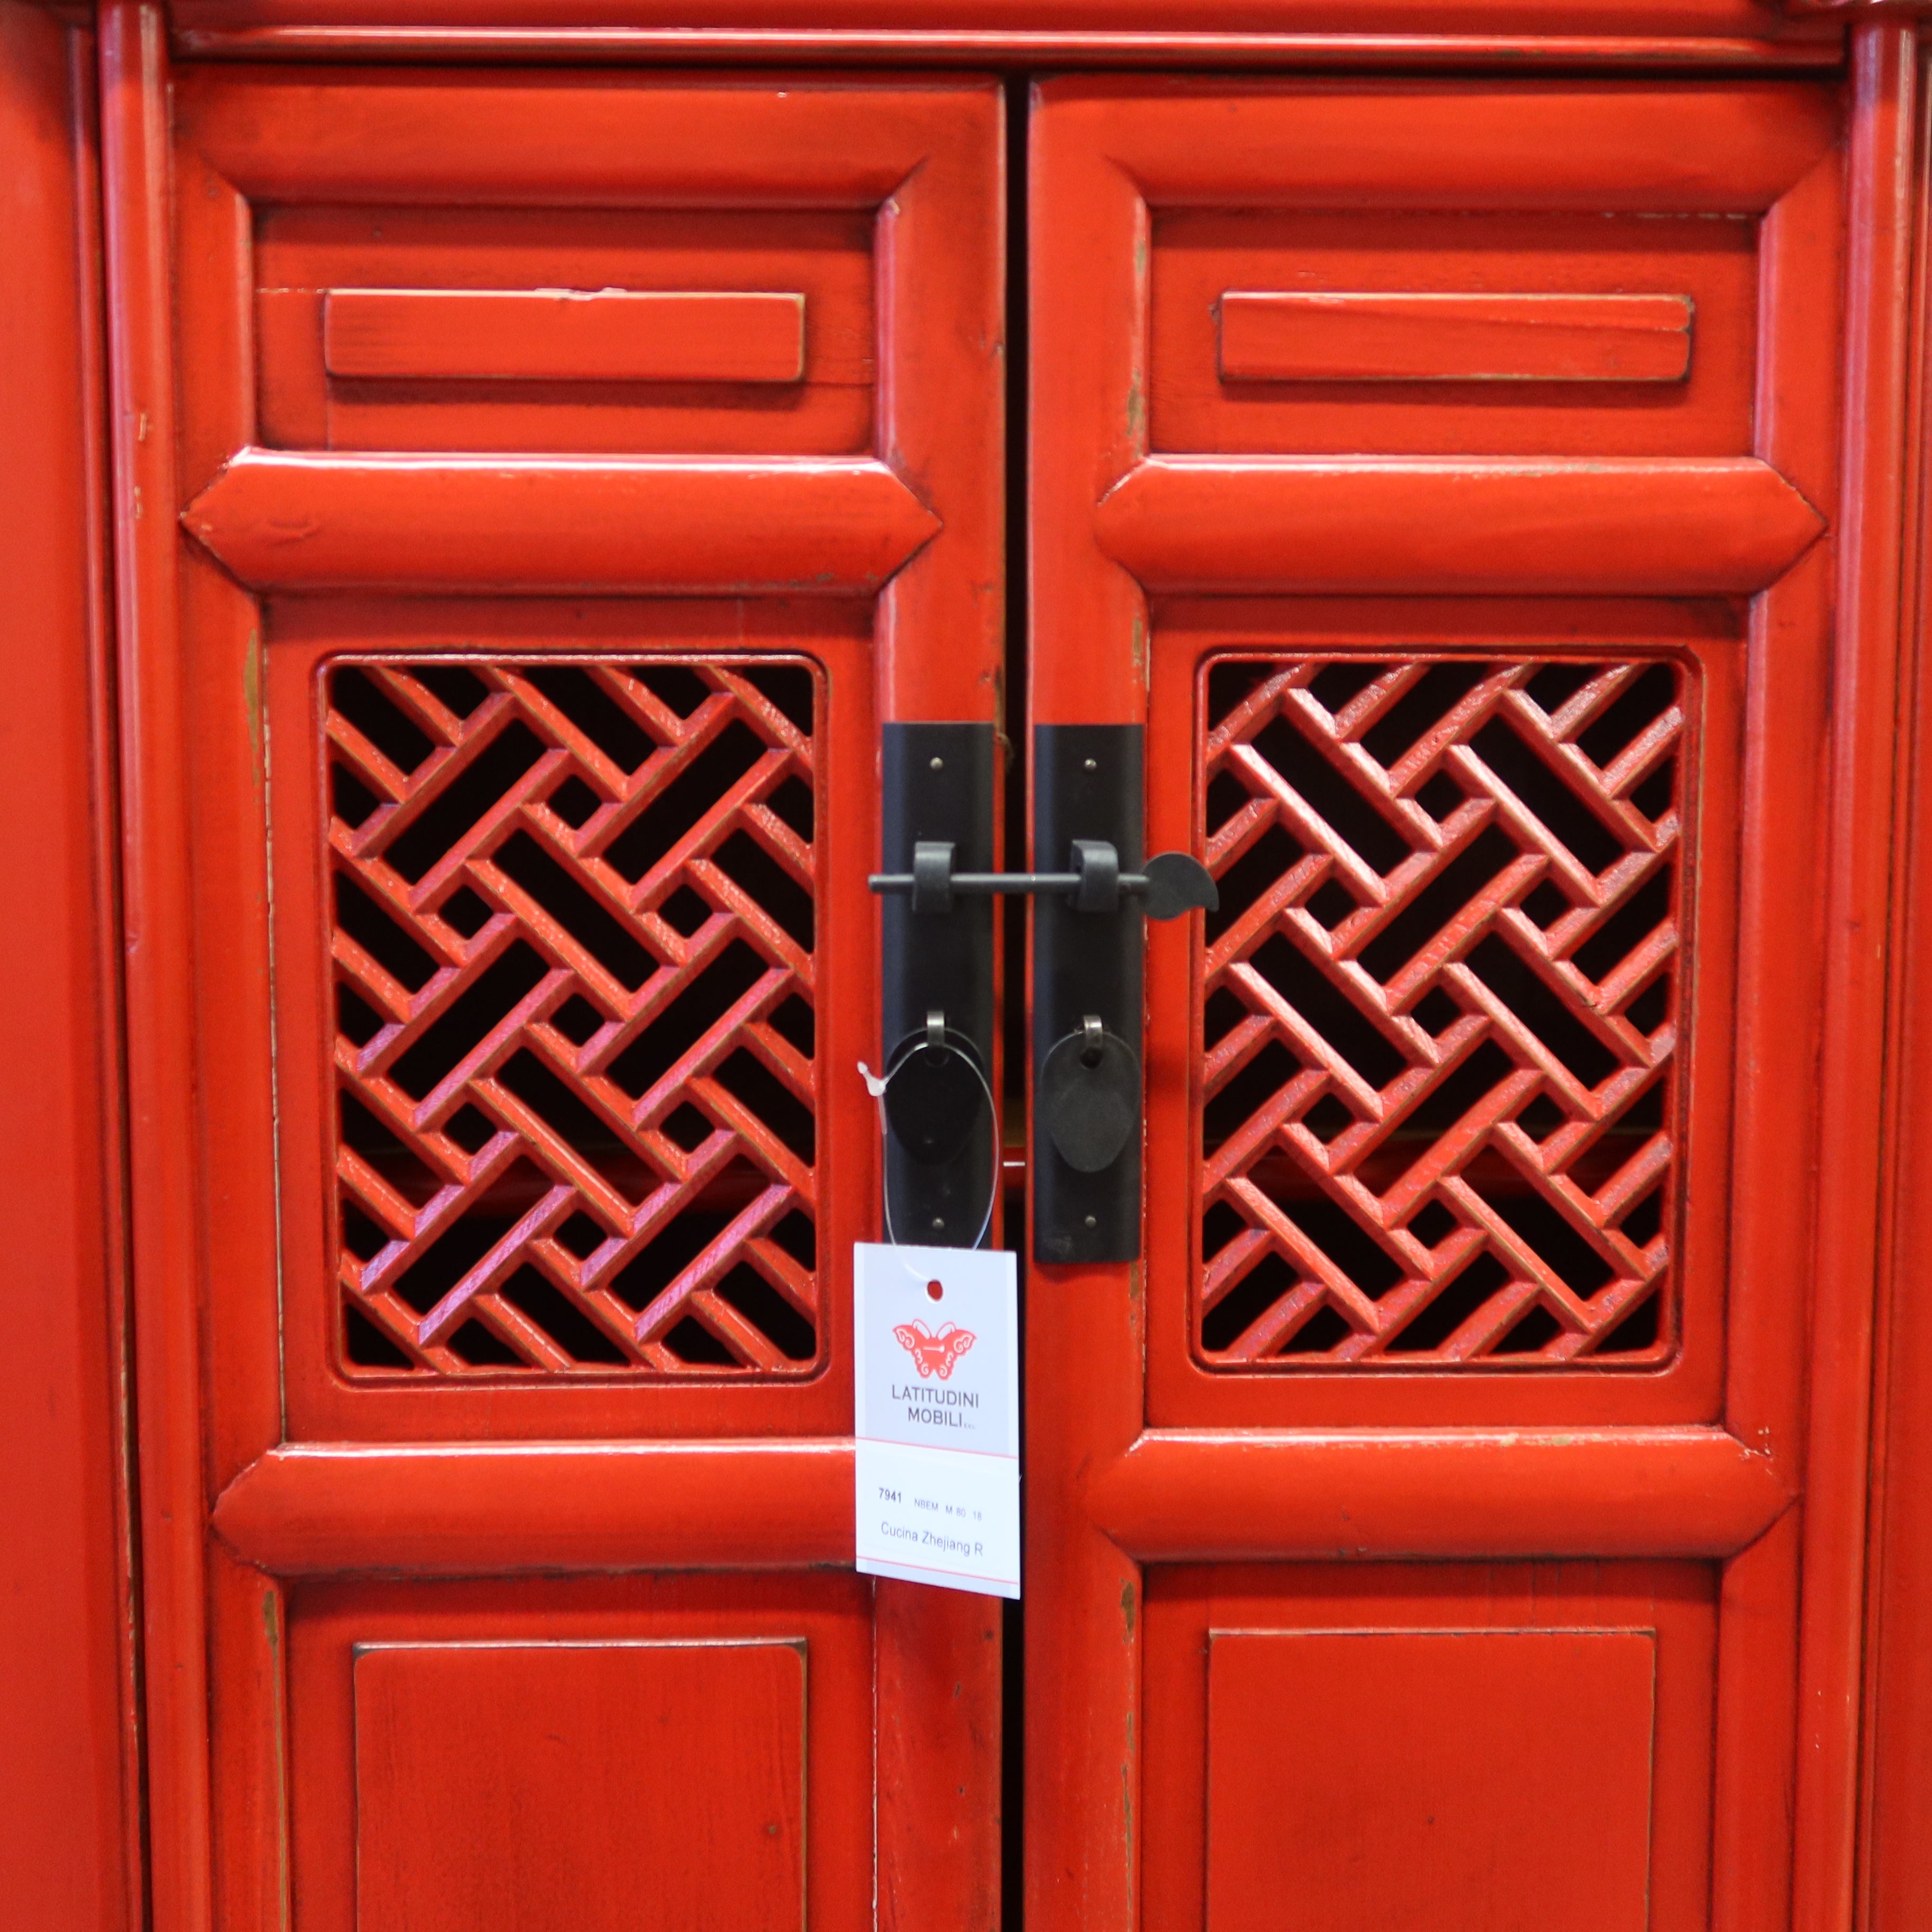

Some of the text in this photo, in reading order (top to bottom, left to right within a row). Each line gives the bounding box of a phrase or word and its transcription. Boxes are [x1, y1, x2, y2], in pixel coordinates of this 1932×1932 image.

[892, 1384, 979, 1408] LATITUDINI
[908, 1406, 962, 1427] MOBILI
[879, 1487, 901, 1503] 7941
[945, 1505, 953, 1515] M
[881, 1521, 983, 1557] Cucina Zhejiang R
